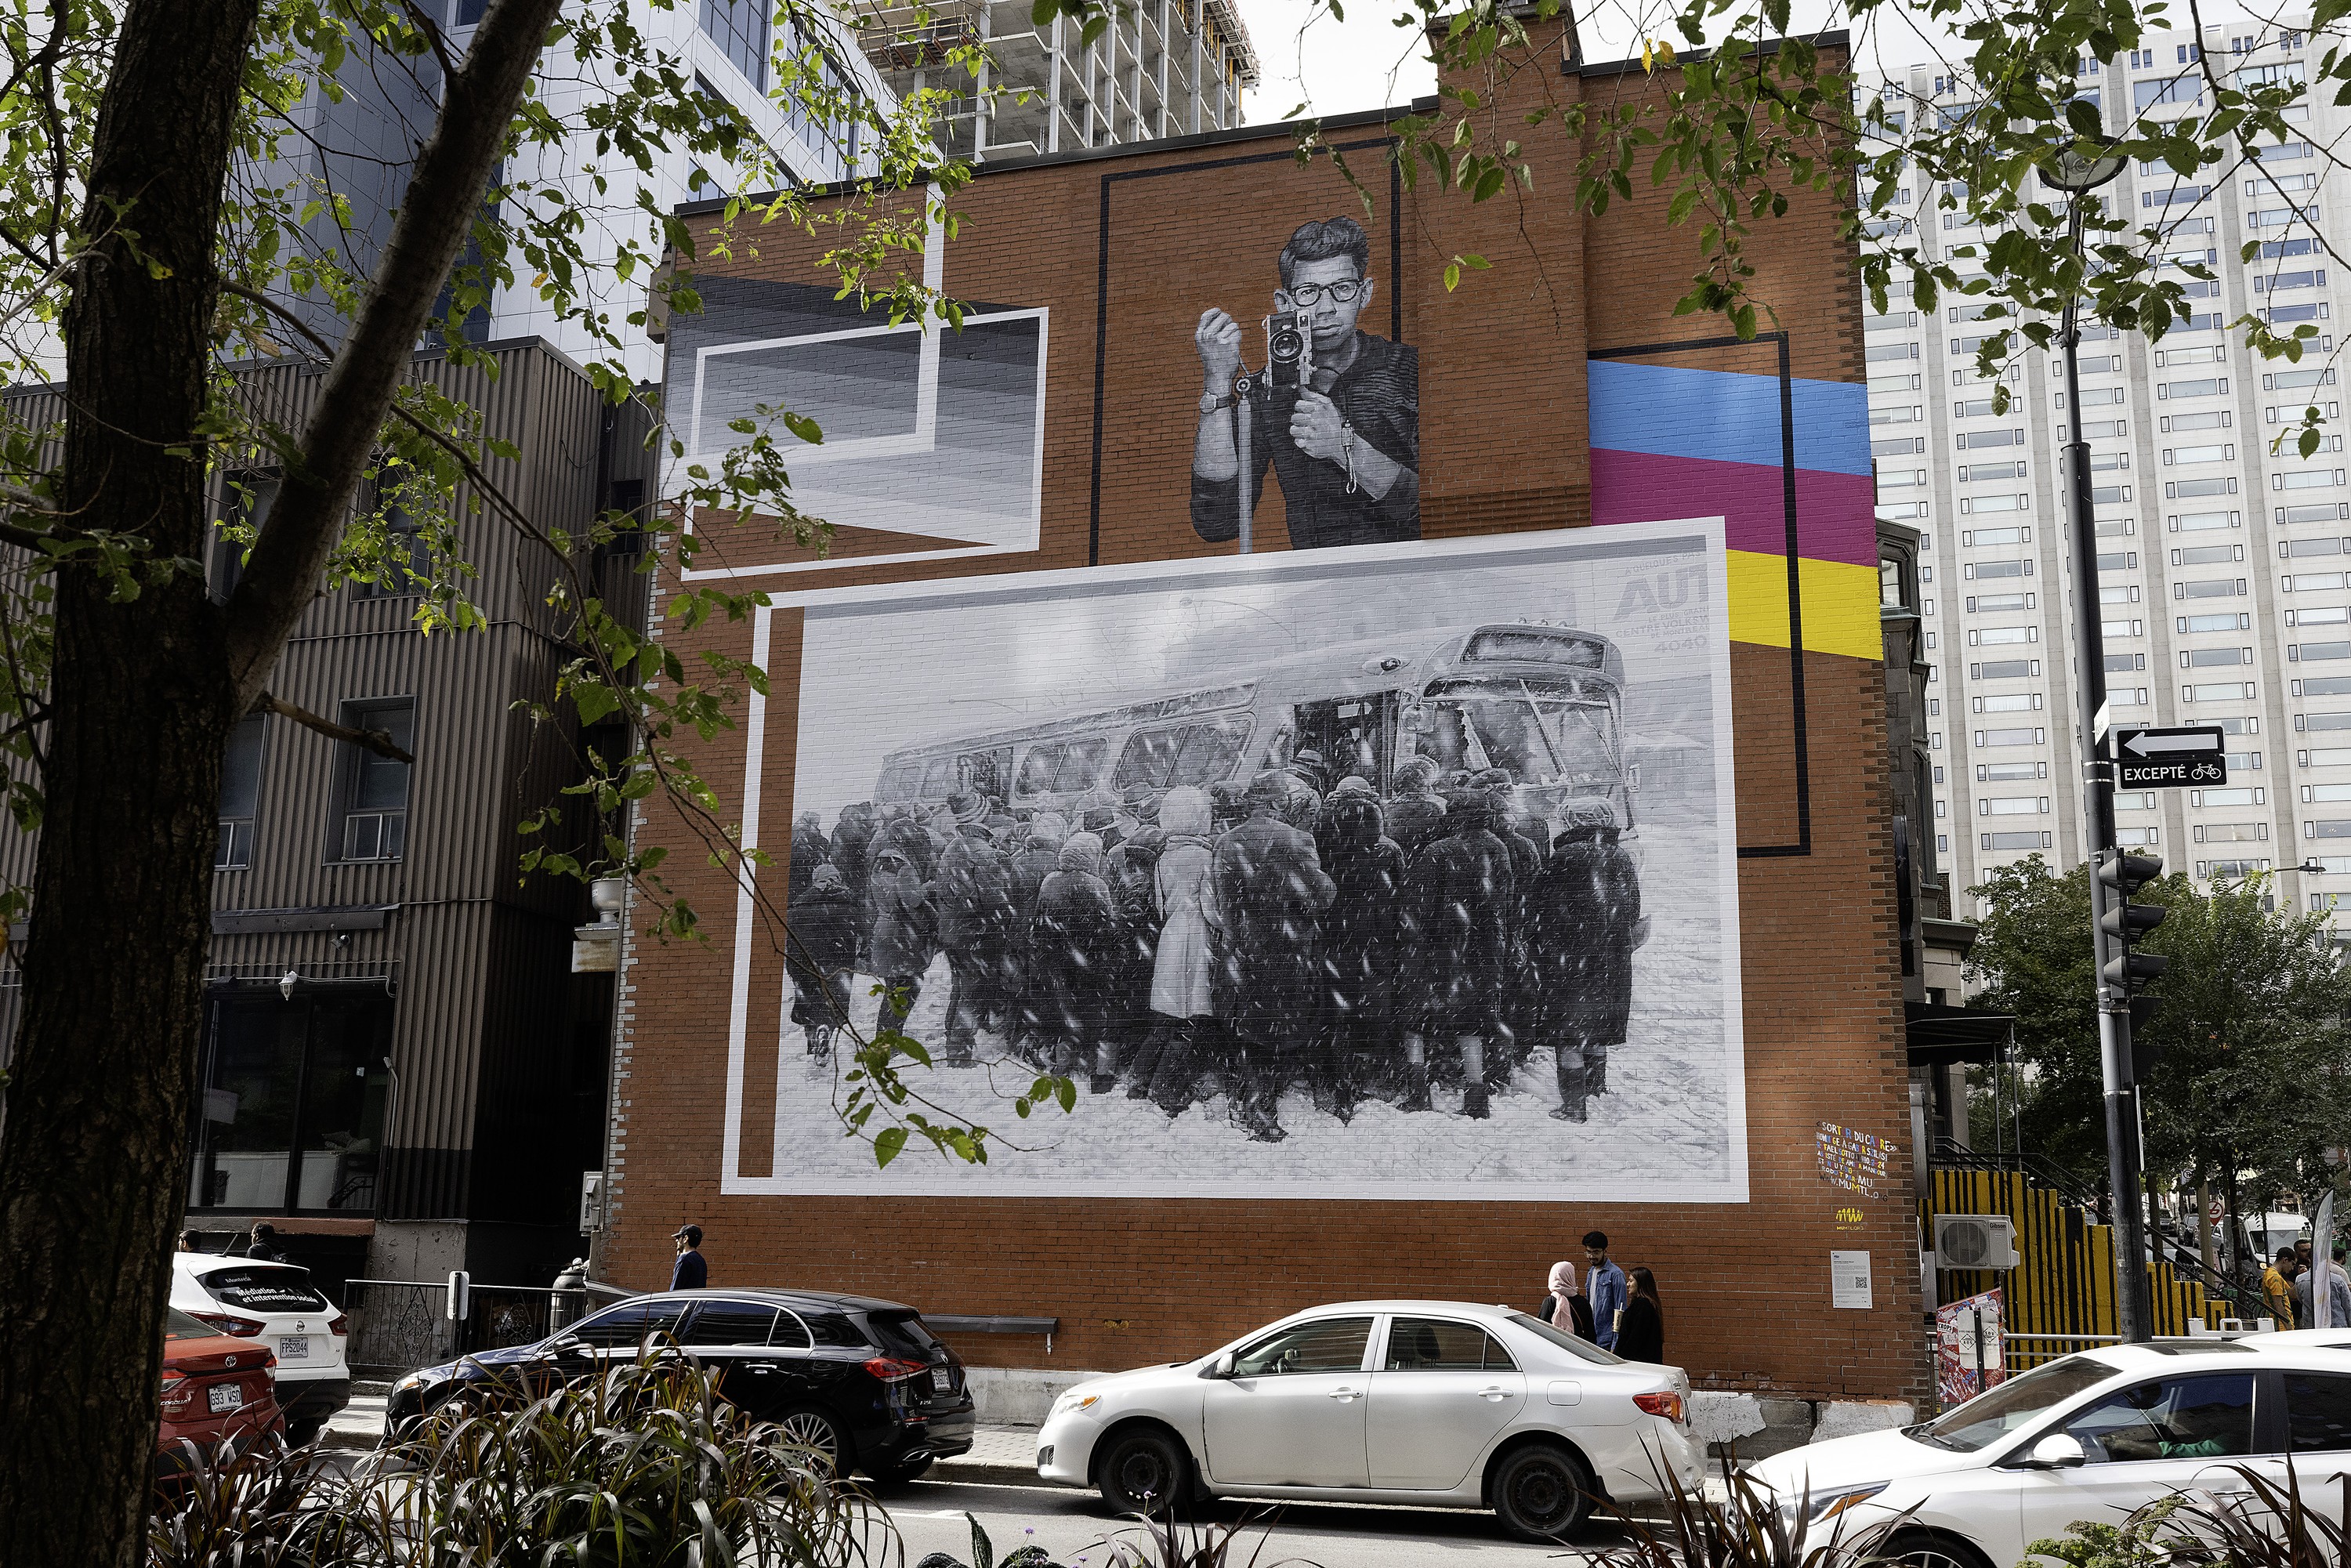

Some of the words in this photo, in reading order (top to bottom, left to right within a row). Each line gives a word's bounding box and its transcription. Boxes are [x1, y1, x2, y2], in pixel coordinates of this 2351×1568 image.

[1612, 563, 1708, 622] AUT
[1616, 625, 1660, 638] CENTRE
[1654, 636, 1707, 653] 4040
[2124, 764, 2186, 780] EXCEPTÉ
[1822, 1121, 1852, 1139] SORTIR
[1854, 1131, 1864, 1143] DU
[1857, 1175, 1873, 1187] MU
[236, 1287, 277, 1297] Médiation
[252, 1294, 298, 1302] intervention
[297, 1295, 319, 1304] sociale
[1938, 1323, 1952, 1331] CROPS
[281, 1342, 307, 1353] FPS2044
[210, 1392, 224, 1406] G93
[227, 1389, 241, 1403] WSD
